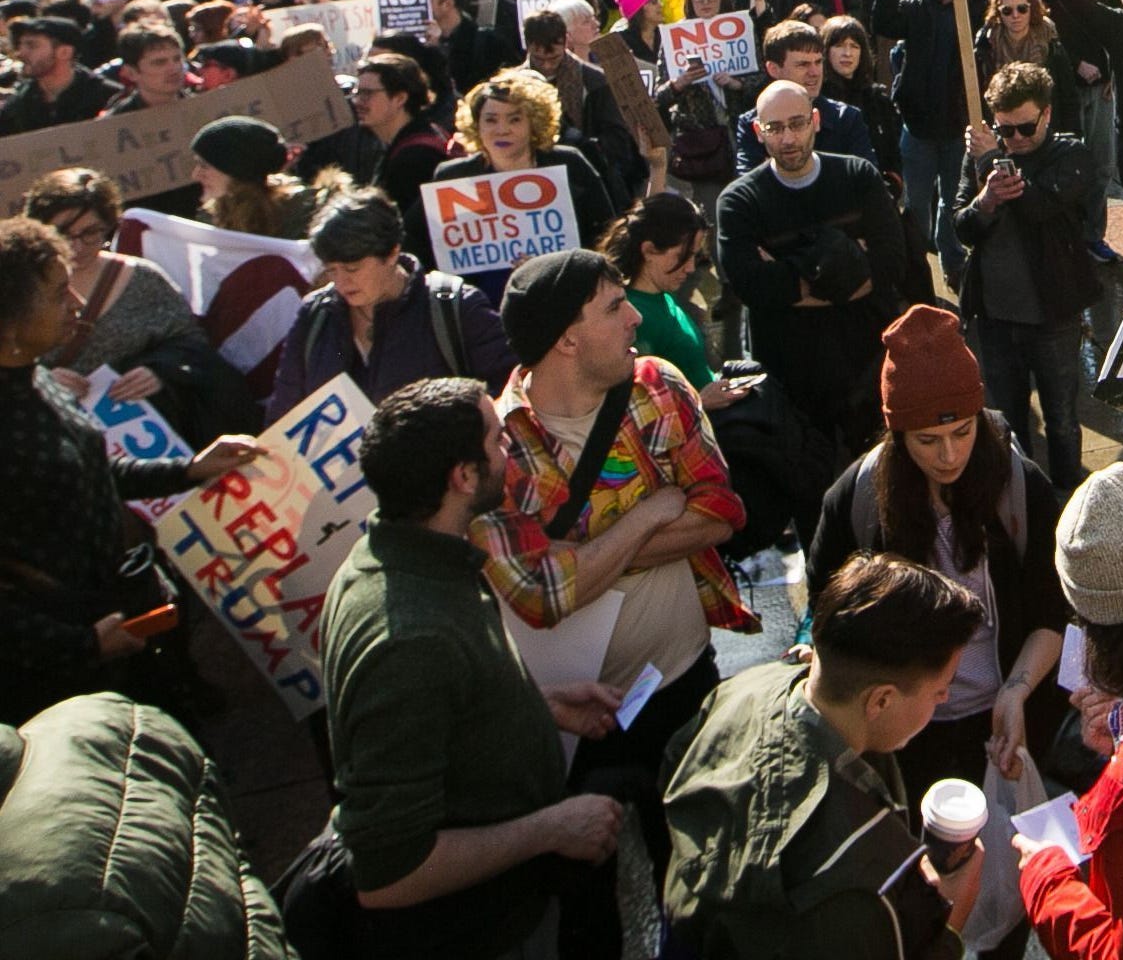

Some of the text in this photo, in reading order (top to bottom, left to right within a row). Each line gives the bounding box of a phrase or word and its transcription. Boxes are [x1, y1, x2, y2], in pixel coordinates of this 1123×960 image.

[670, 16, 746, 49] NO
[727, 38, 748, 56] TO
[436, 174, 558, 224] NO
[443, 208, 563, 247] CUTS TO
[448, 234, 566, 270] MEDICARE
[173, 510, 321, 703] TRUMP
